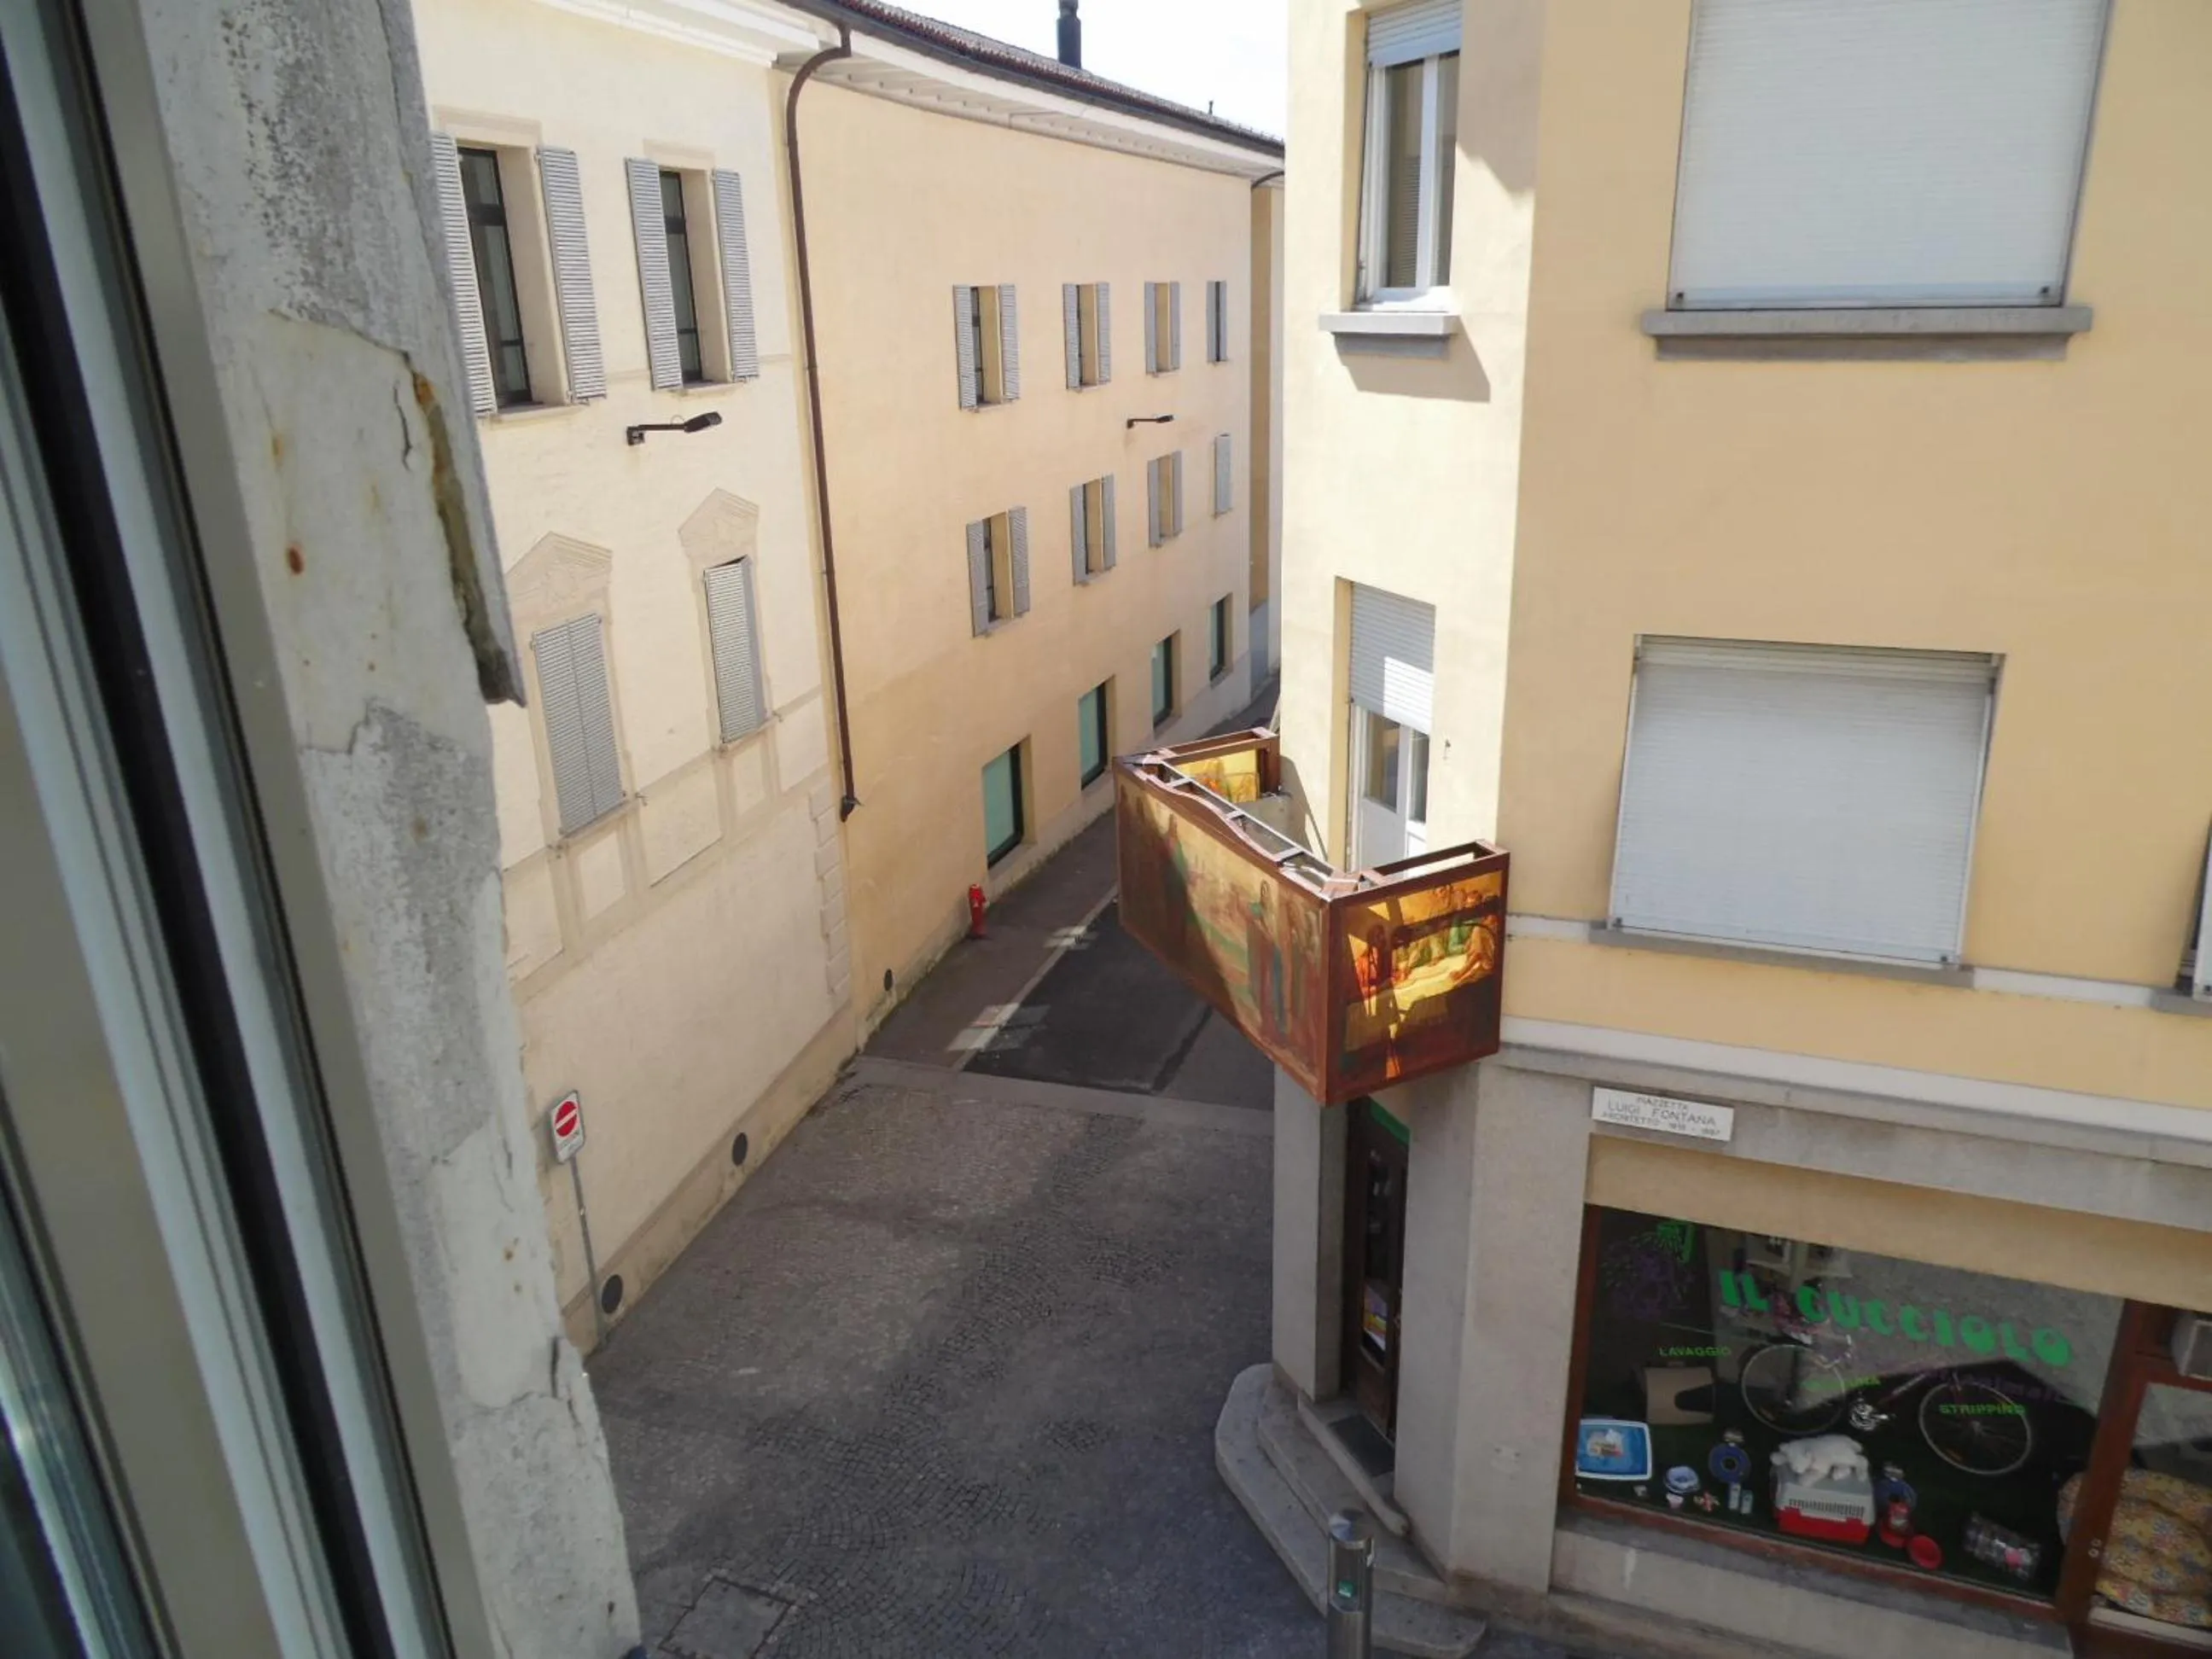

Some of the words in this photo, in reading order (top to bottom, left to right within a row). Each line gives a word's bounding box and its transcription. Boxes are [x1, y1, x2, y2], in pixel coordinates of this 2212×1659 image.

[1608, 1096, 1640, 1115] LUIGI
[1651, 1108, 1717, 1127] FONTANA
[1718, 1269, 1770, 1313] IL
[1796, 1284, 2073, 1367] CUCCIOLO
[1658, 1346, 1732, 1358] LAVAGGIO
[1939, 1403, 2025, 1416] STRIPPING
